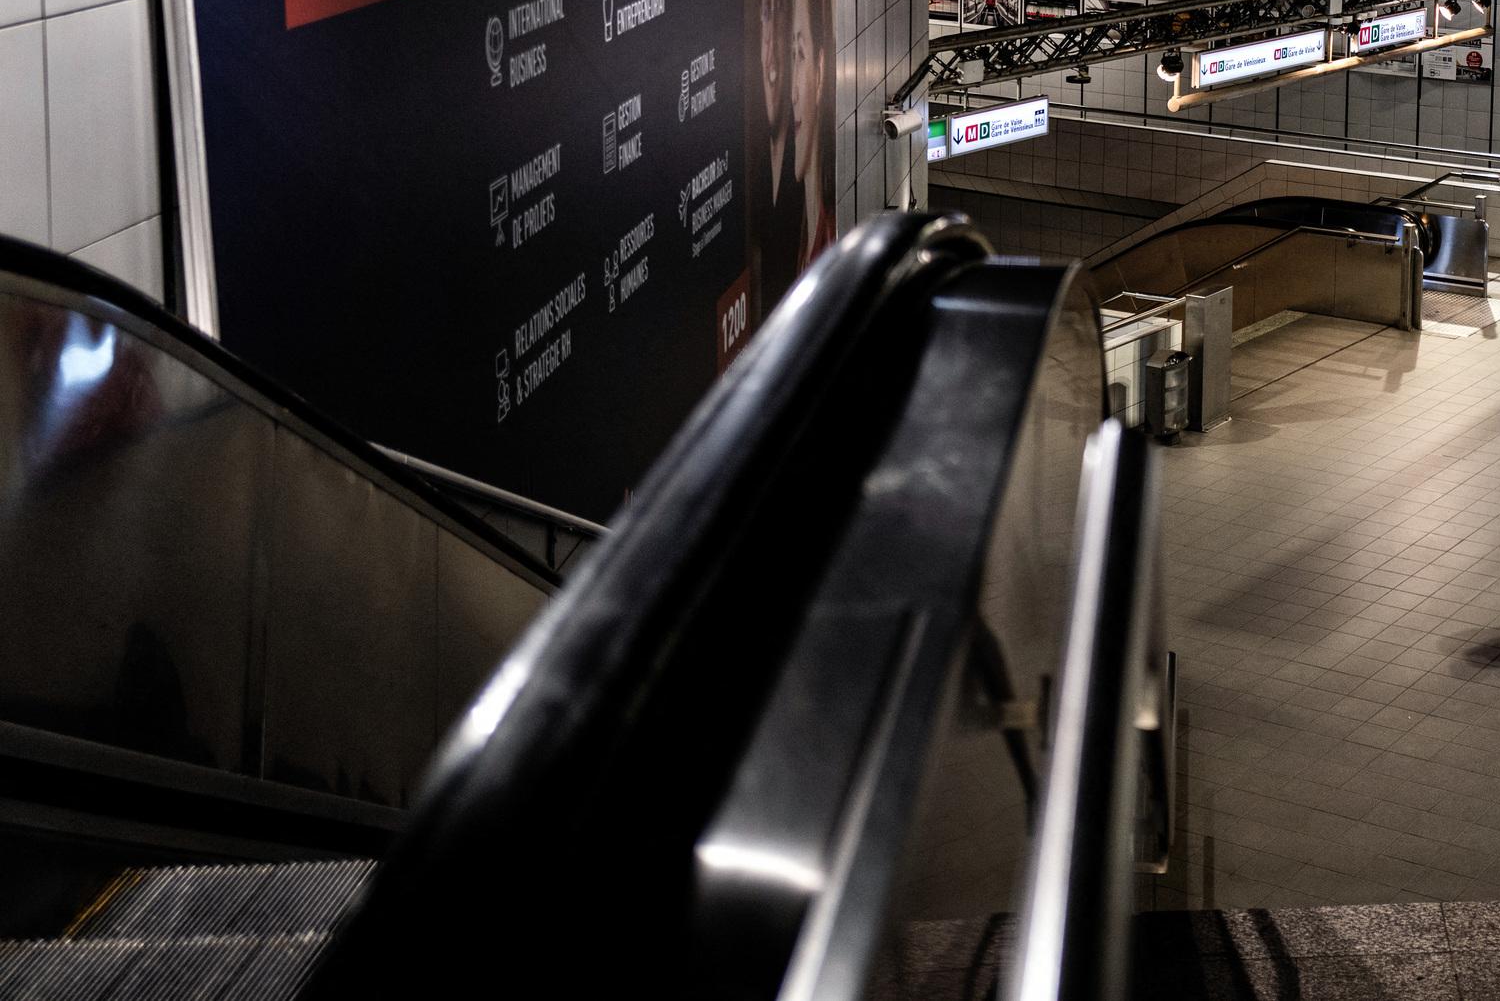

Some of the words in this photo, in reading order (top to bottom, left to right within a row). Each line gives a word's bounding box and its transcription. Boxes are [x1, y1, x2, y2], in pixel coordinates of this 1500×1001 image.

[1360, 28, 1370, 45] M
[1372, 26, 1379, 41] D
[509, 43, 547, 88] BUSINESS
[1225, 62, 1236, 71] Gare
[618, 94, 641, 131] GESTION
[966, 125, 978, 142] M
[980, 123, 989, 139] D
[511, 143, 561, 202] MANAGEMENT
[619, 132, 642, 171] FINANCE
[513, 214, 522, 249] DE
[524, 192, 555, 242] PROJETS
[620, 213, 654, 264] RESSOURCES
[515, 299, 554, 359] RELATIONS
[554, 272, 586, 324] SOCIALES
[722, 292, 747, 353] 1200
[524, 337, 560, 399] STRATÉGIE
[561, 329, 572, 362] RH
